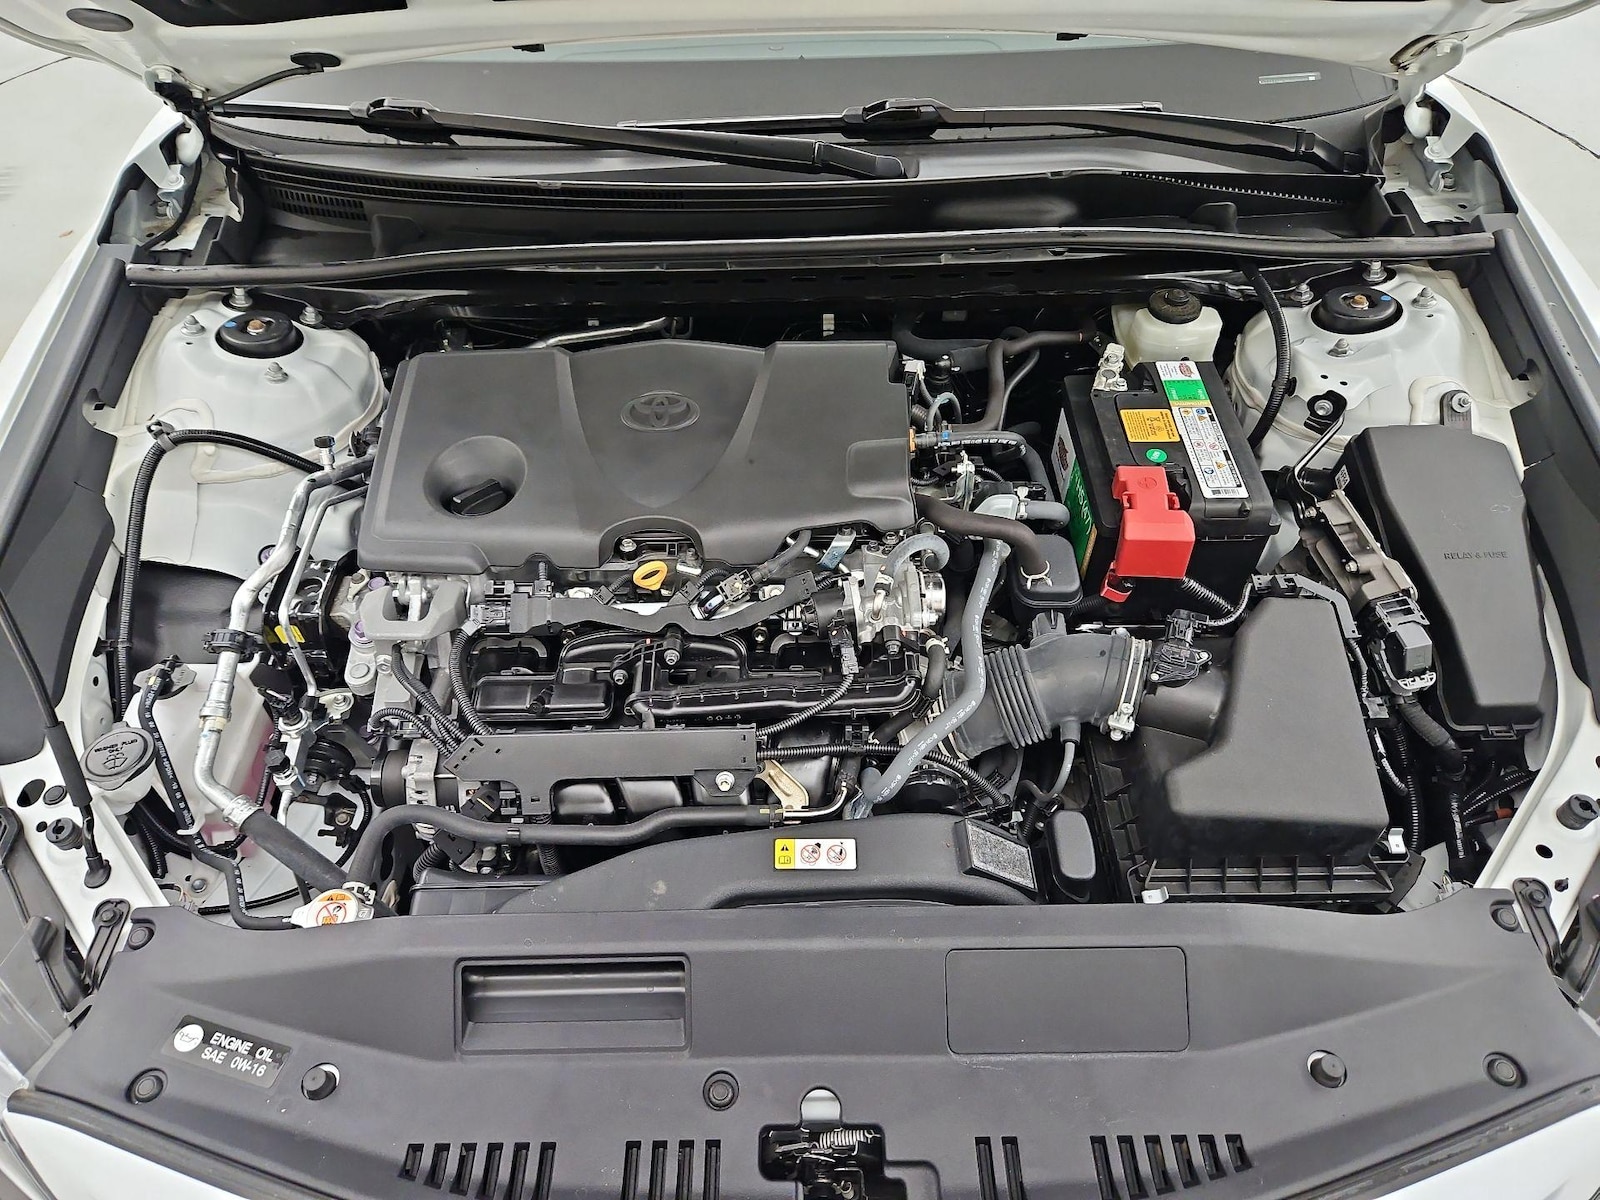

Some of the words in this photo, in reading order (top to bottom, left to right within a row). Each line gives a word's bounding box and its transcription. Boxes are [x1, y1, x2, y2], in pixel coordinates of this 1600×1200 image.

[1443, 551, 1473, 560] RELAY
[1484, 551, 1508, 559] FUSE
[210, 1031, 253, 1055] ENGINE
[255, 1047, 274, 1062] OIL
[201, 1047, 227, 1064] SAE
[230, 1056, 267, 1077] 0W-16
